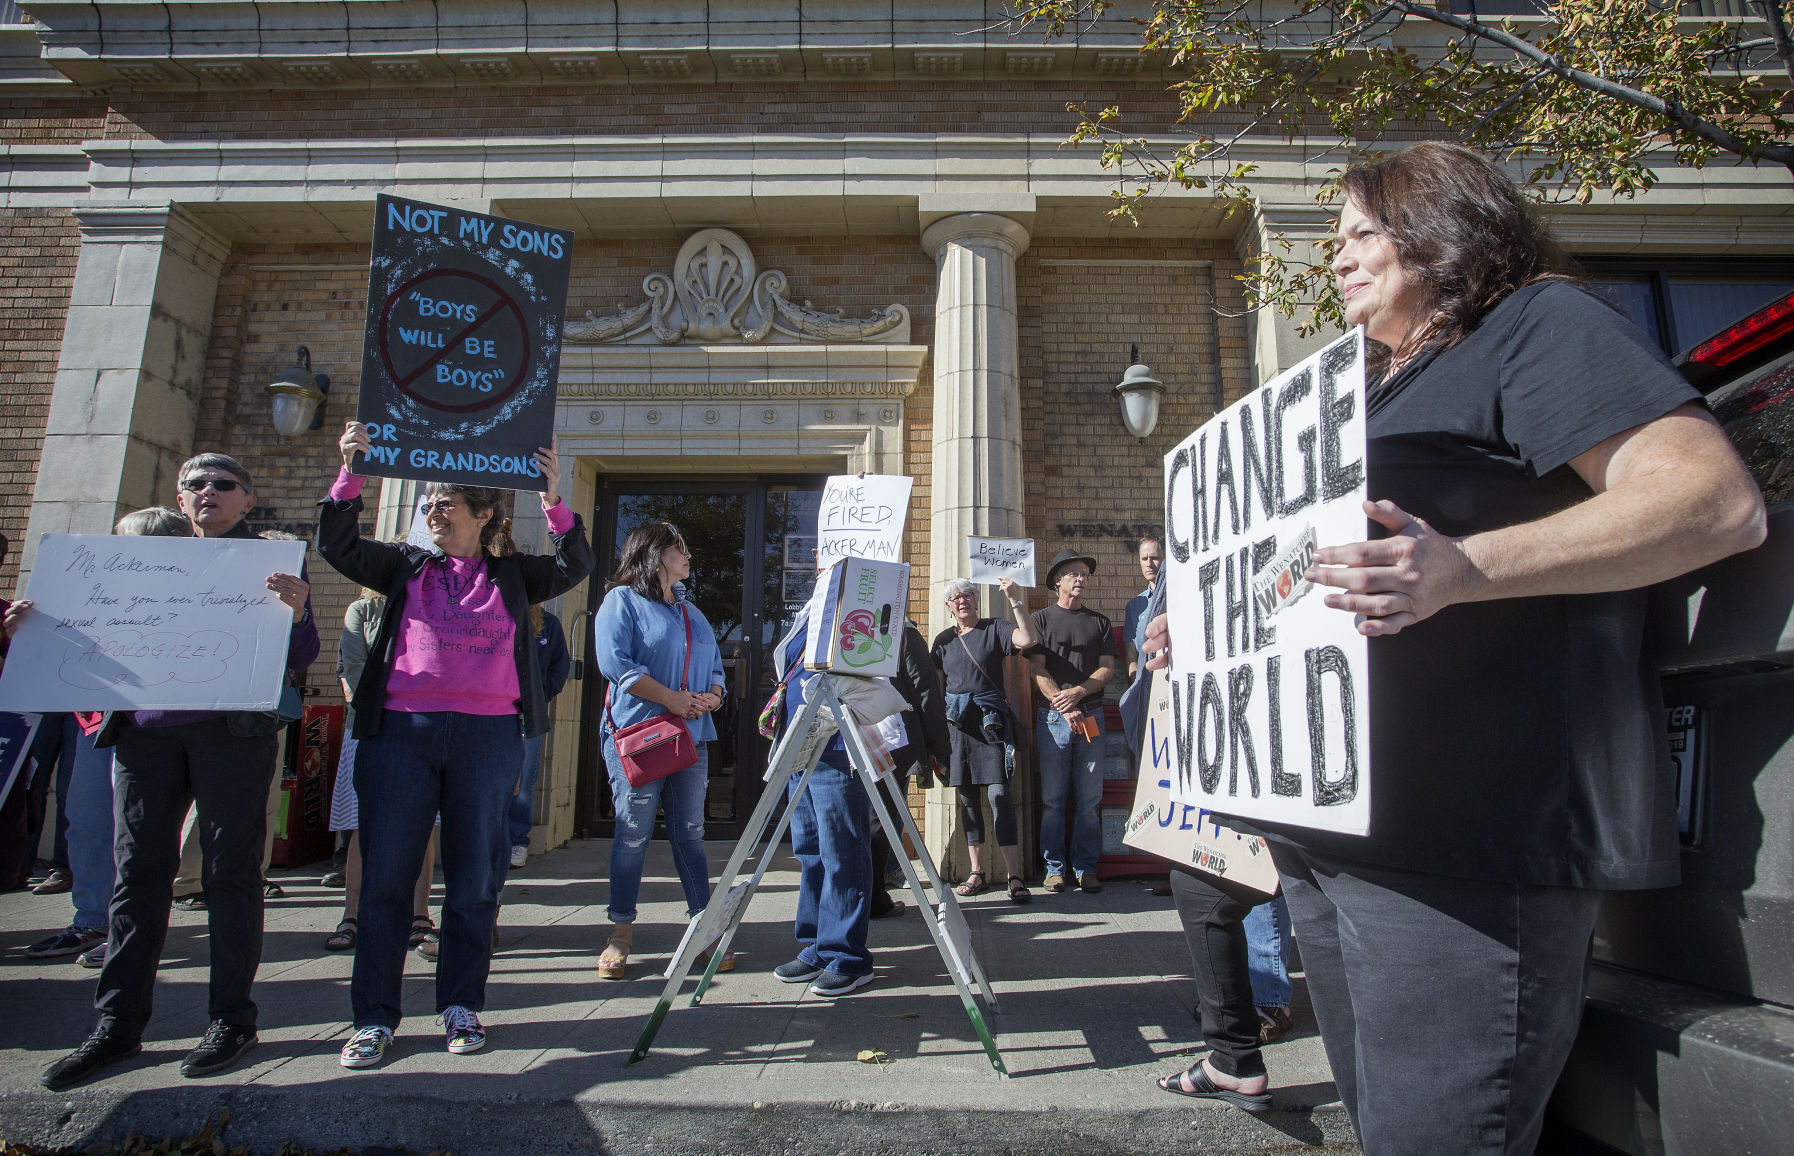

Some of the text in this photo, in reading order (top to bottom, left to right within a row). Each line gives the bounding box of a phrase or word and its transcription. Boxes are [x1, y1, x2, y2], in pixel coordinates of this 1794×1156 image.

[387, 202, 566, 259] NOT MY SONS
[408, 291, 478, 322] "BOYS
[399, 327, 498, 358] WILL BE
[436, 364, 506, 392] BOYS"
[365, 422, 399, 442] OR
[1166, 333, 1365, 563] CHANGE
[364, 444, 542, 479] MY GRANDSONS
[980, 543, 1027, 556] Believe
[85, 582, 272, 614] Have you ever trivialized
[858, 568, 870, 605] FRUIT
[866, 568, 878, 606] SELECT
[1199, 535, 1277, 661] THE
[55, 616, 96, 631] sexual
[1172, 645, 1359, 807] WORLD
